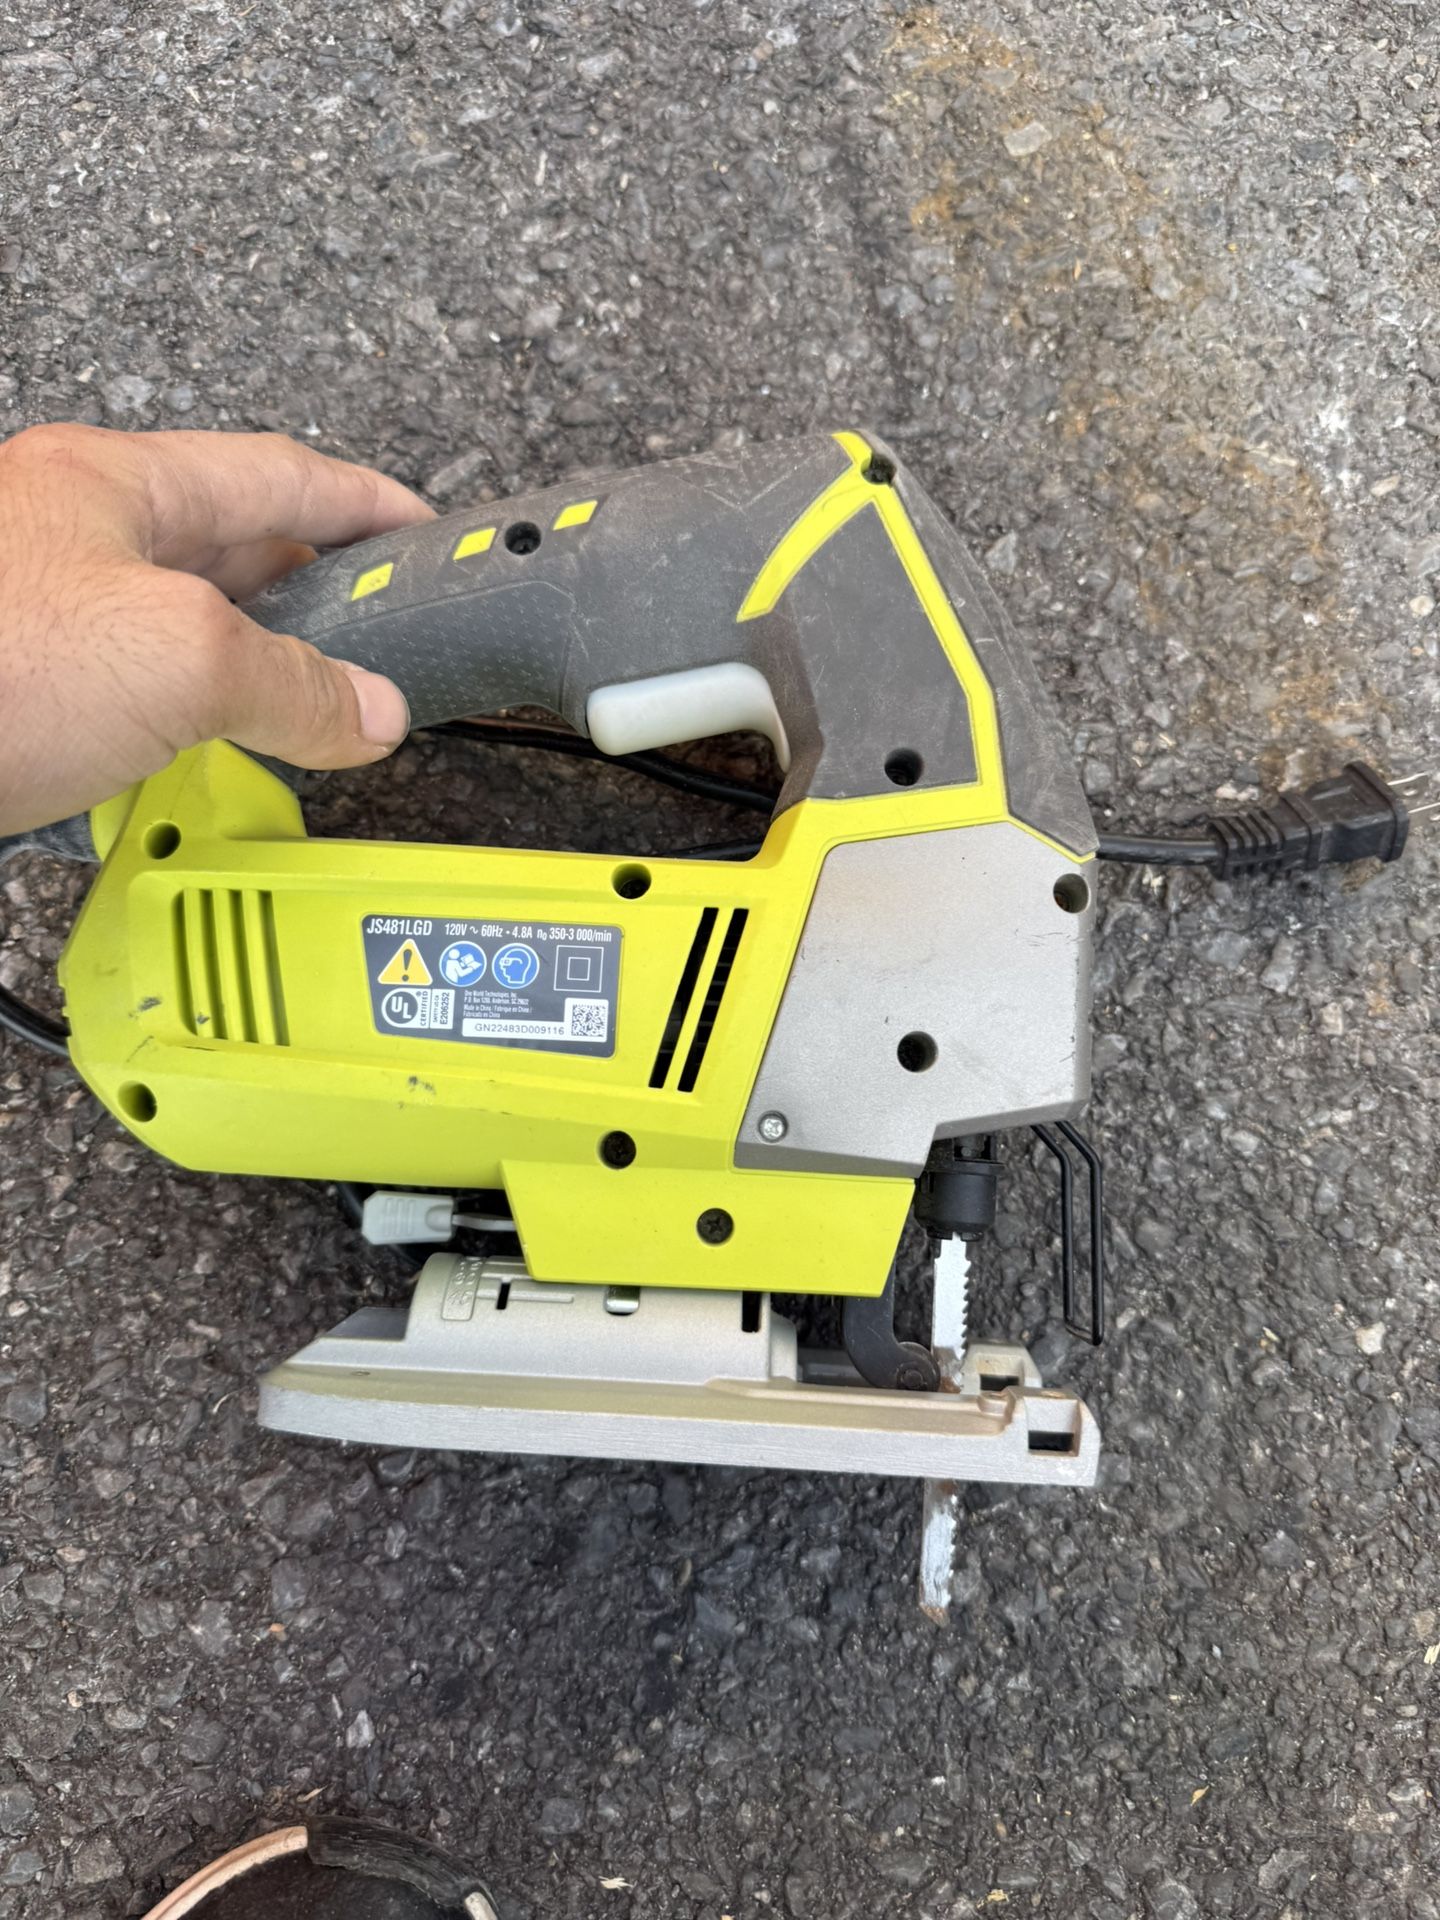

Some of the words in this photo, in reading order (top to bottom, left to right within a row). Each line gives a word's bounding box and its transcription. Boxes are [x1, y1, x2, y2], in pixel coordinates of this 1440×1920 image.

[367, 918, 432, 936] JS481LGD
[445, 923, 467, 936] 120V
[481, 924, 503, 938] 60Hz
[512, 925, 532, 939] 4.8A
[549, 927, 574, 941] 350-3
[576, 928, 612, 942] 000/min
[391, 996, 412, 1019] UL
[420, 991, 428, 1026] CERTIFIED
[439, 992, 450, 1025] E206252
[474, 1023, 565, 1035] GN22483D009116
